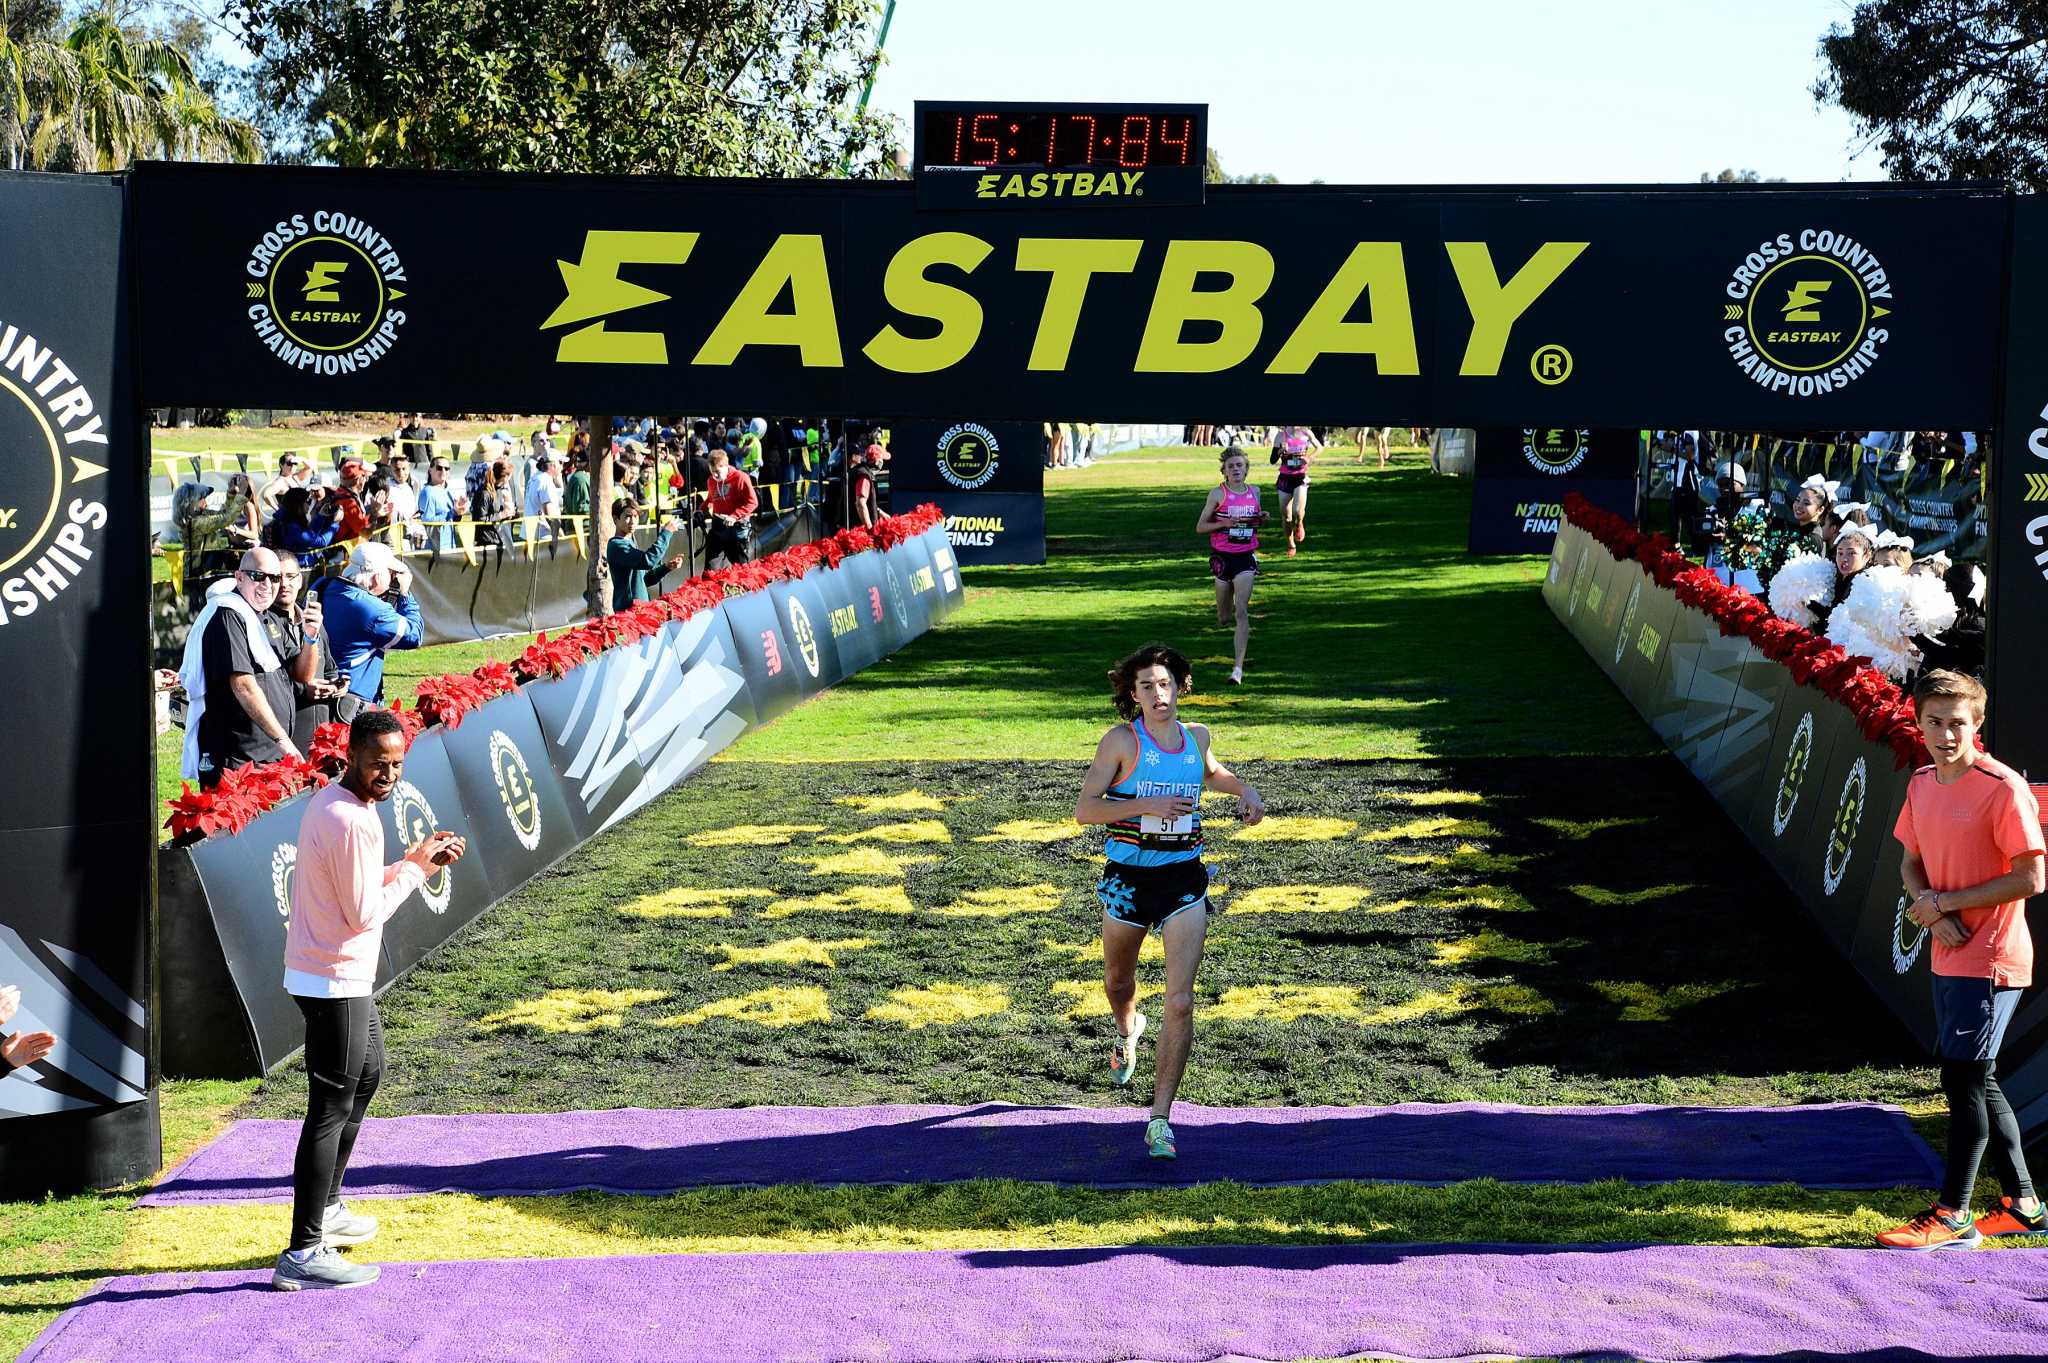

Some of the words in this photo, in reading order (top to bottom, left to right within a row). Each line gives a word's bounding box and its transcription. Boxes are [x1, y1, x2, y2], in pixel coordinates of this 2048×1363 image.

[246, 214, 309, 278] CROSS
[313, 210, 407, 282] COUNTRY
[1726, 233, 1794, 300] CROSS
[1800, 228, 1893, 300] COUNTRY
[290, 311, 361, 323] EASTBAY
[248, 303, 406, 376] CHAMPIONSHIPS
[1767, 331, 1842, 343] EASTBAY
[1724, 325, 1889, 397] CHAMPIONSHIPS
[937, 424, 962, 451] CROSS
[964, 422, 1000, 452] COUNTRY
[937, 459, 1000, 490] CHAMPIONSHIPS
[1523, 444, 1589, 475] CHAMPIONSHIPS
[1523, 519, 1559, 533] FINA
